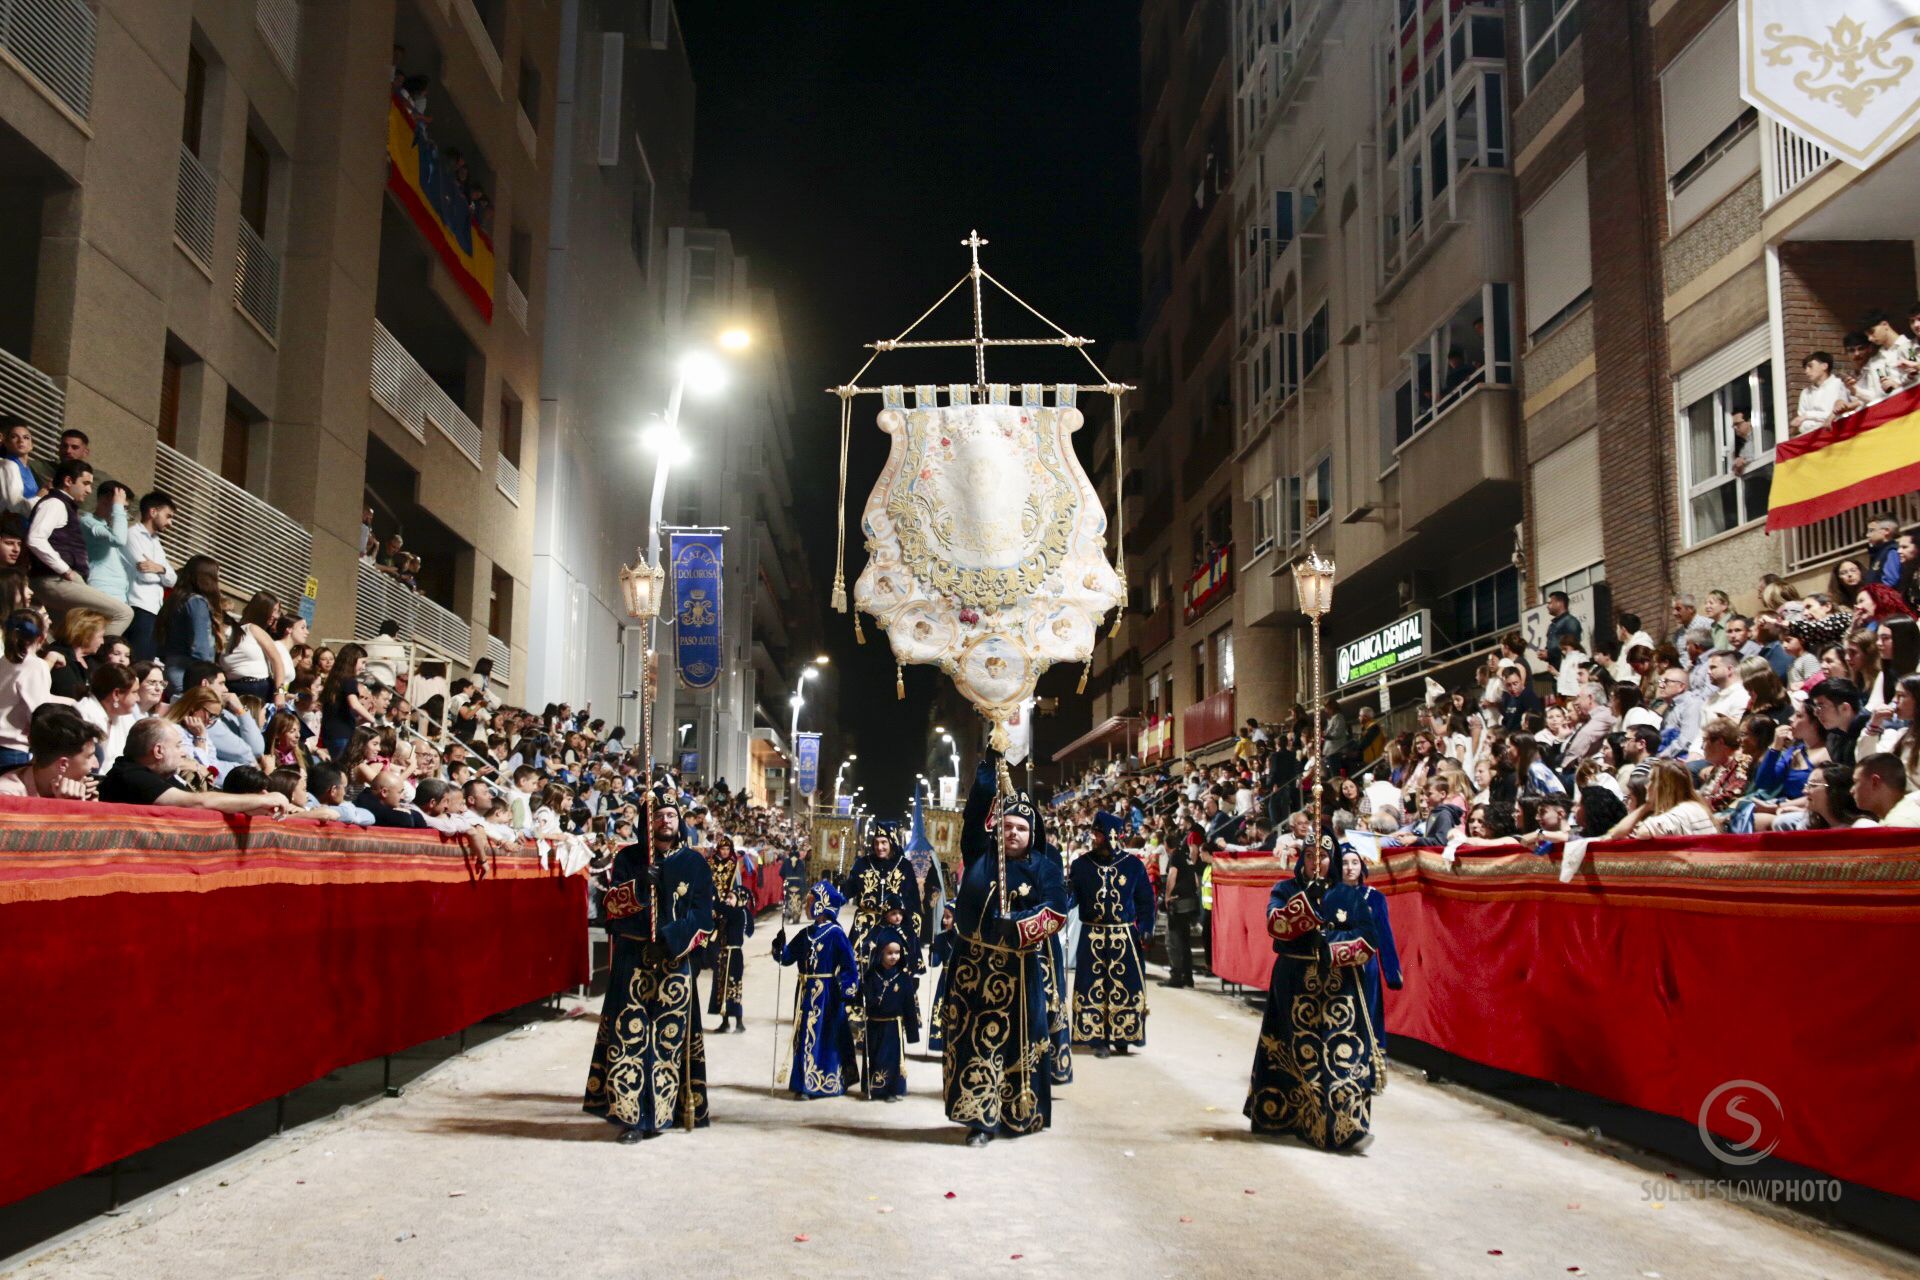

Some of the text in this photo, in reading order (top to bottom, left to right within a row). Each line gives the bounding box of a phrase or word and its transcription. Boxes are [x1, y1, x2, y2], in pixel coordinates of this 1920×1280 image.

[681, 550, 712, 566] MATER
[678, 569, 717, 579] DOLOROSA
[1383, 616, 1421, 651] DENTAL
[680, 636, 716, 646] PASO AZUL
